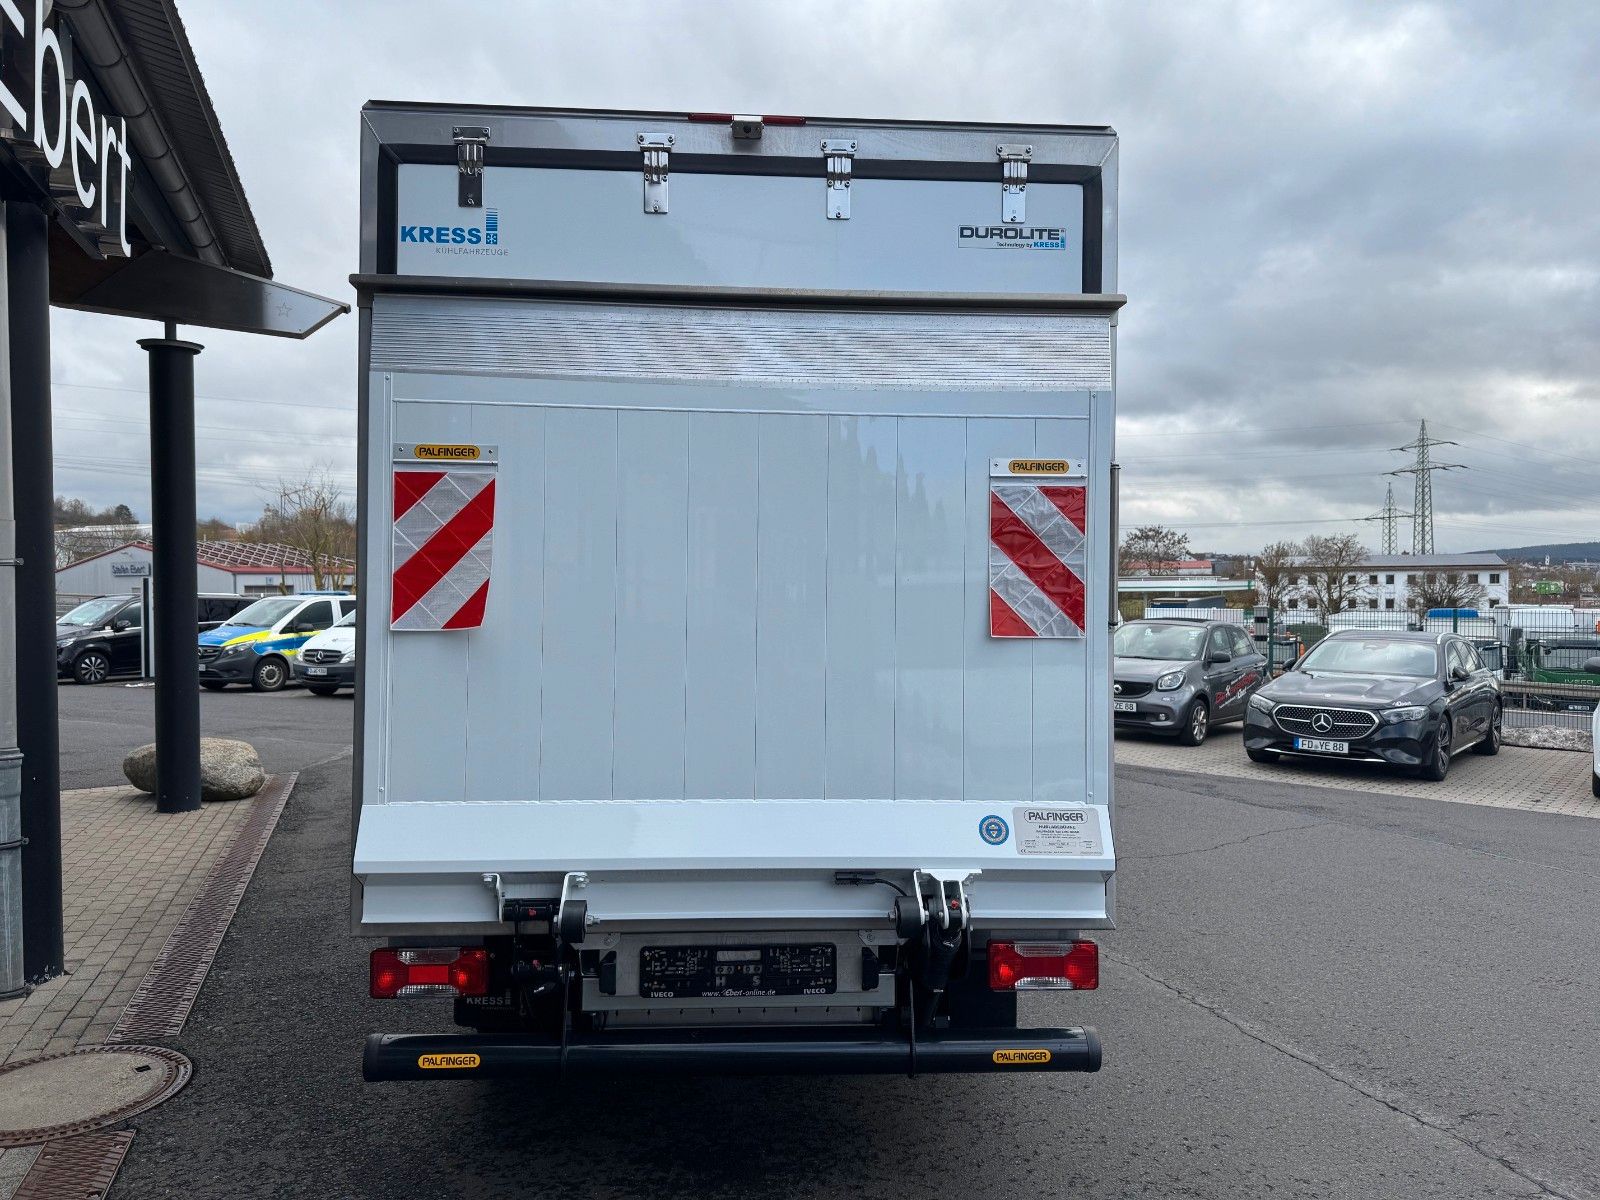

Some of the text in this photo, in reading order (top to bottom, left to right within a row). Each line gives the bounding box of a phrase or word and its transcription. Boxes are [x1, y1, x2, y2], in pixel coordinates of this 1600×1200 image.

[401, 226, 482, 245] KRESS
[959, 227, 1060, 241] DUROLITE
[419, 447, 476, 457] PALFINGER
[1012, 462, 1065, 472] PALFINGER
[1301, 739, 1345, 752] FD YE 88
[1028, 811, 1084, 822] PALFINGER
[803, 987, 826, 995] IVECO
[466, 996, 505, 1006] KRESS
[422, 1055, 477, 1068] PALFINGER
[997, 1052, 1047, 1062] PALFINGER
